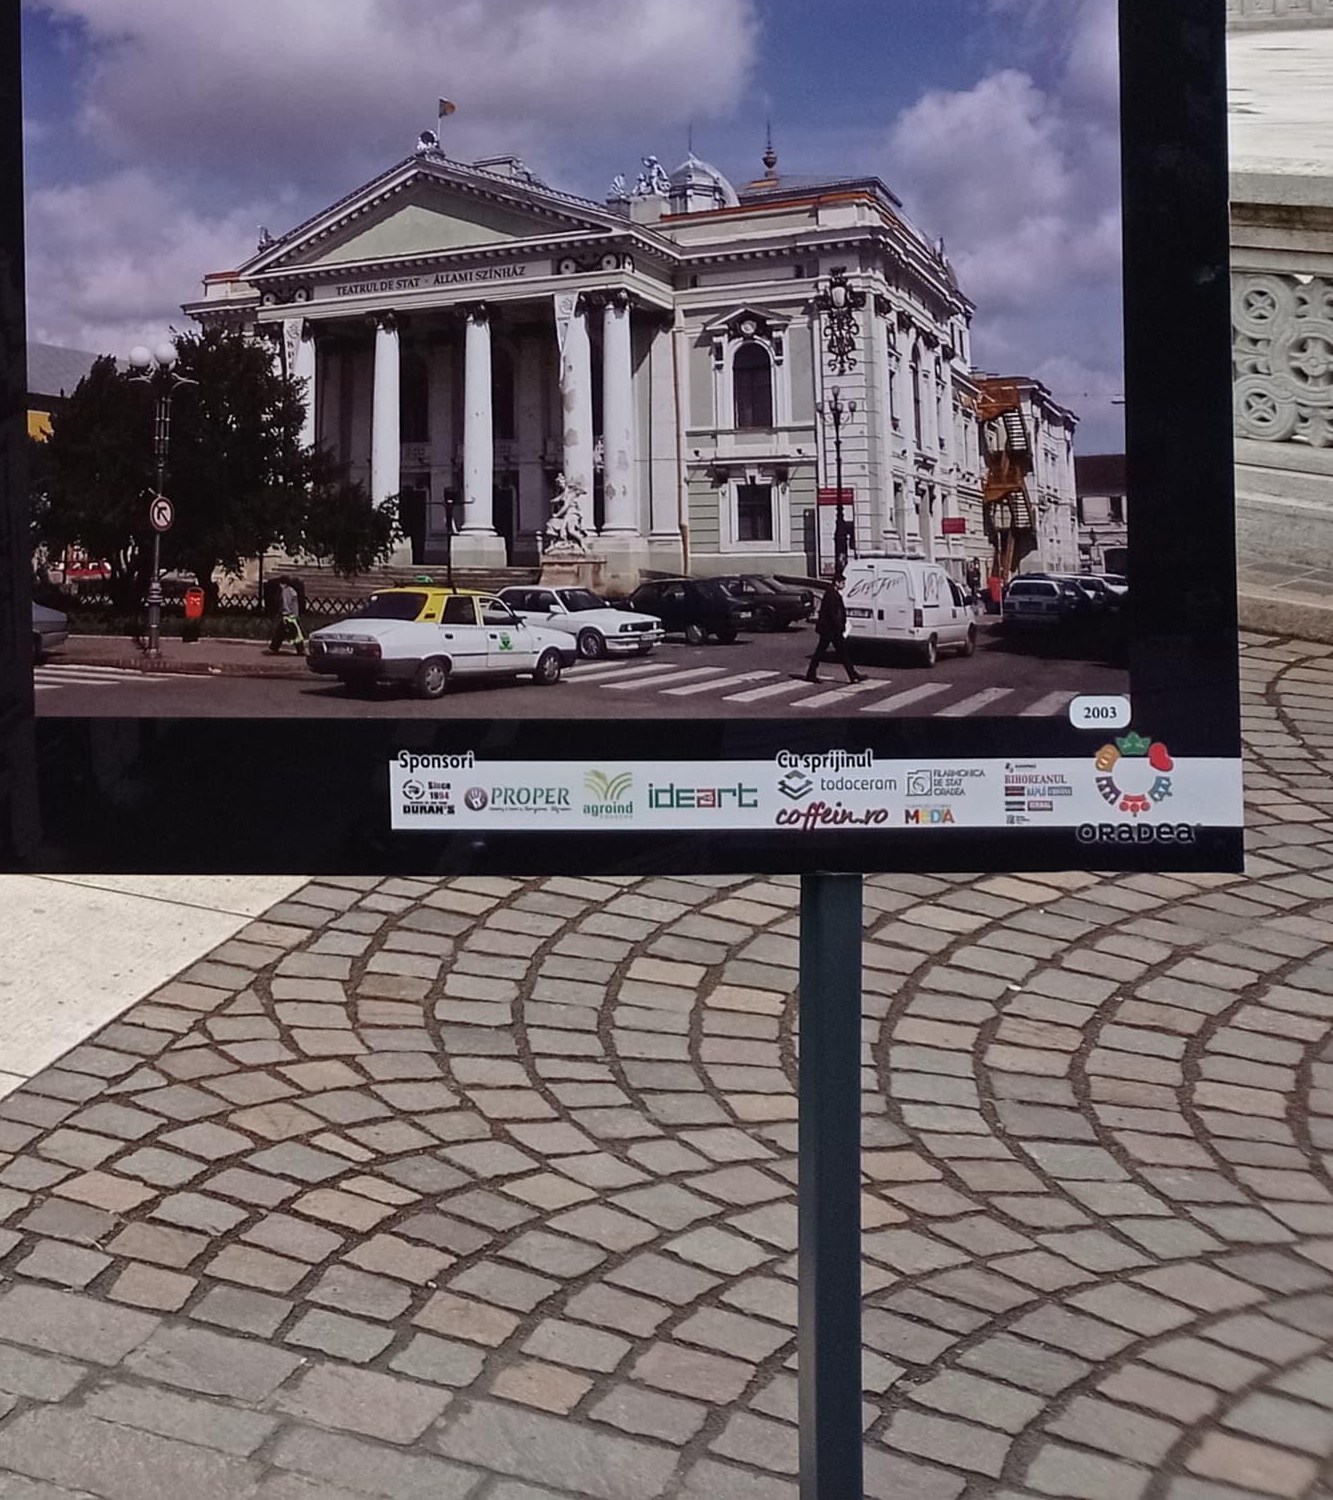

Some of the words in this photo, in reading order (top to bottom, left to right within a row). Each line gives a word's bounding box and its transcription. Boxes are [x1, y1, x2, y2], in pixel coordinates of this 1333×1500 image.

[336, 283, 378, 296] TEATRUL
[380, 281, 394, 291] DE
[396, 278, 421, 289] STAT
[1084, 706, 1117, 719] 2003
[399, 751, 474, 773] Sponsori
[777, 751, 798, 768] Cu
[803, 750, 873, 773] sprijinul
[820, 776, 898, 791] todoceram
[491, 786, 571, 806] PROPER
[583, 801, 633, 816] agroind
[775, 801, 889, 831] coffein.ro
